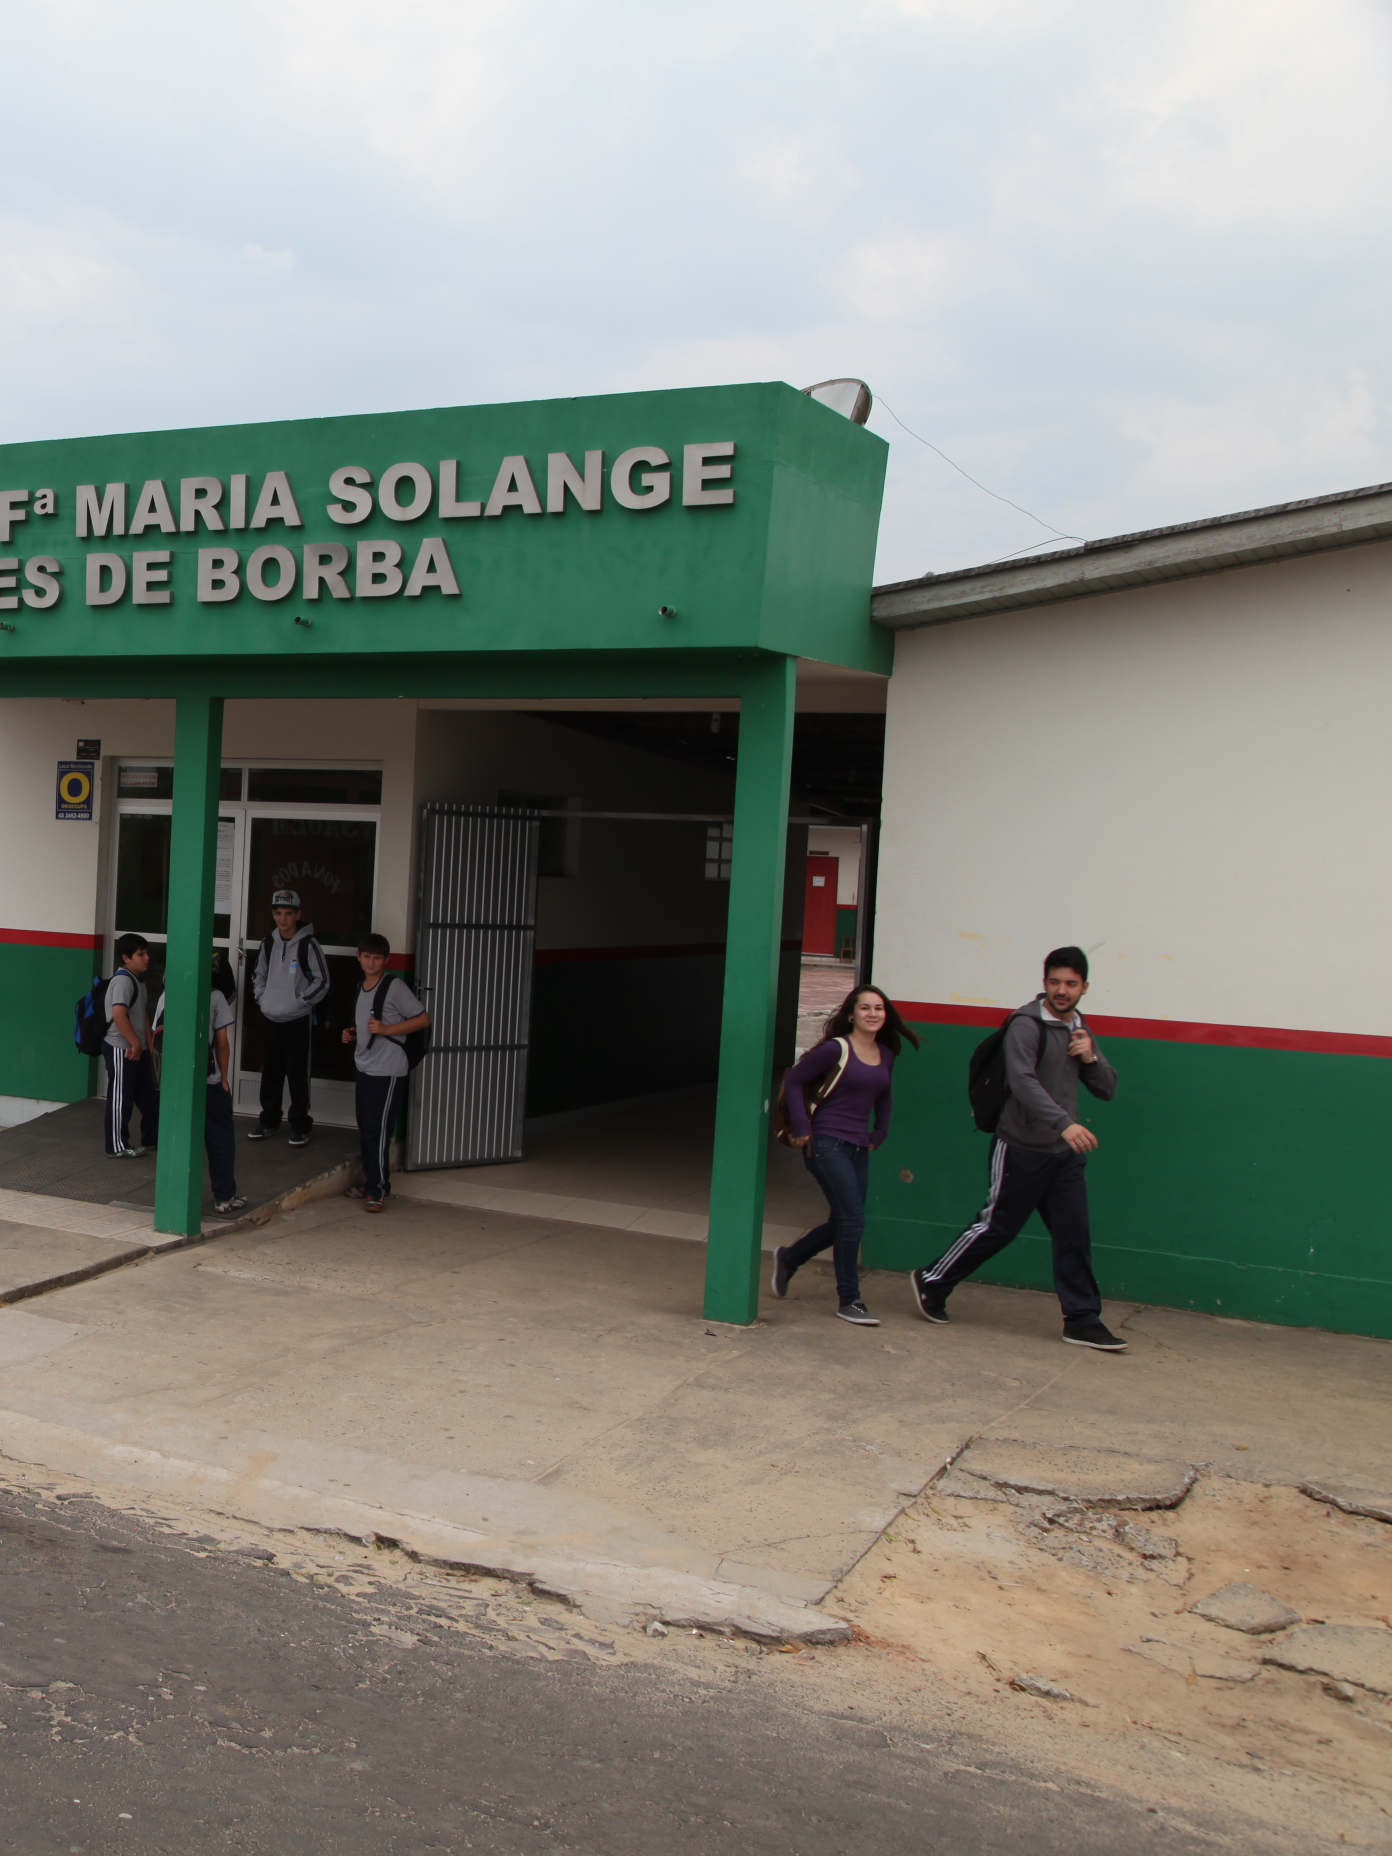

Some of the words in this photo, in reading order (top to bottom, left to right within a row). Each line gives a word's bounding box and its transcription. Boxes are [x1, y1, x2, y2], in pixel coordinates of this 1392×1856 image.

[75, 471, 304, 538] MARIA
[326, 441, 736, 526] SOLANGE
[86, 550, 174, 606] DE
[197, 537, 461, 603] BORBA
